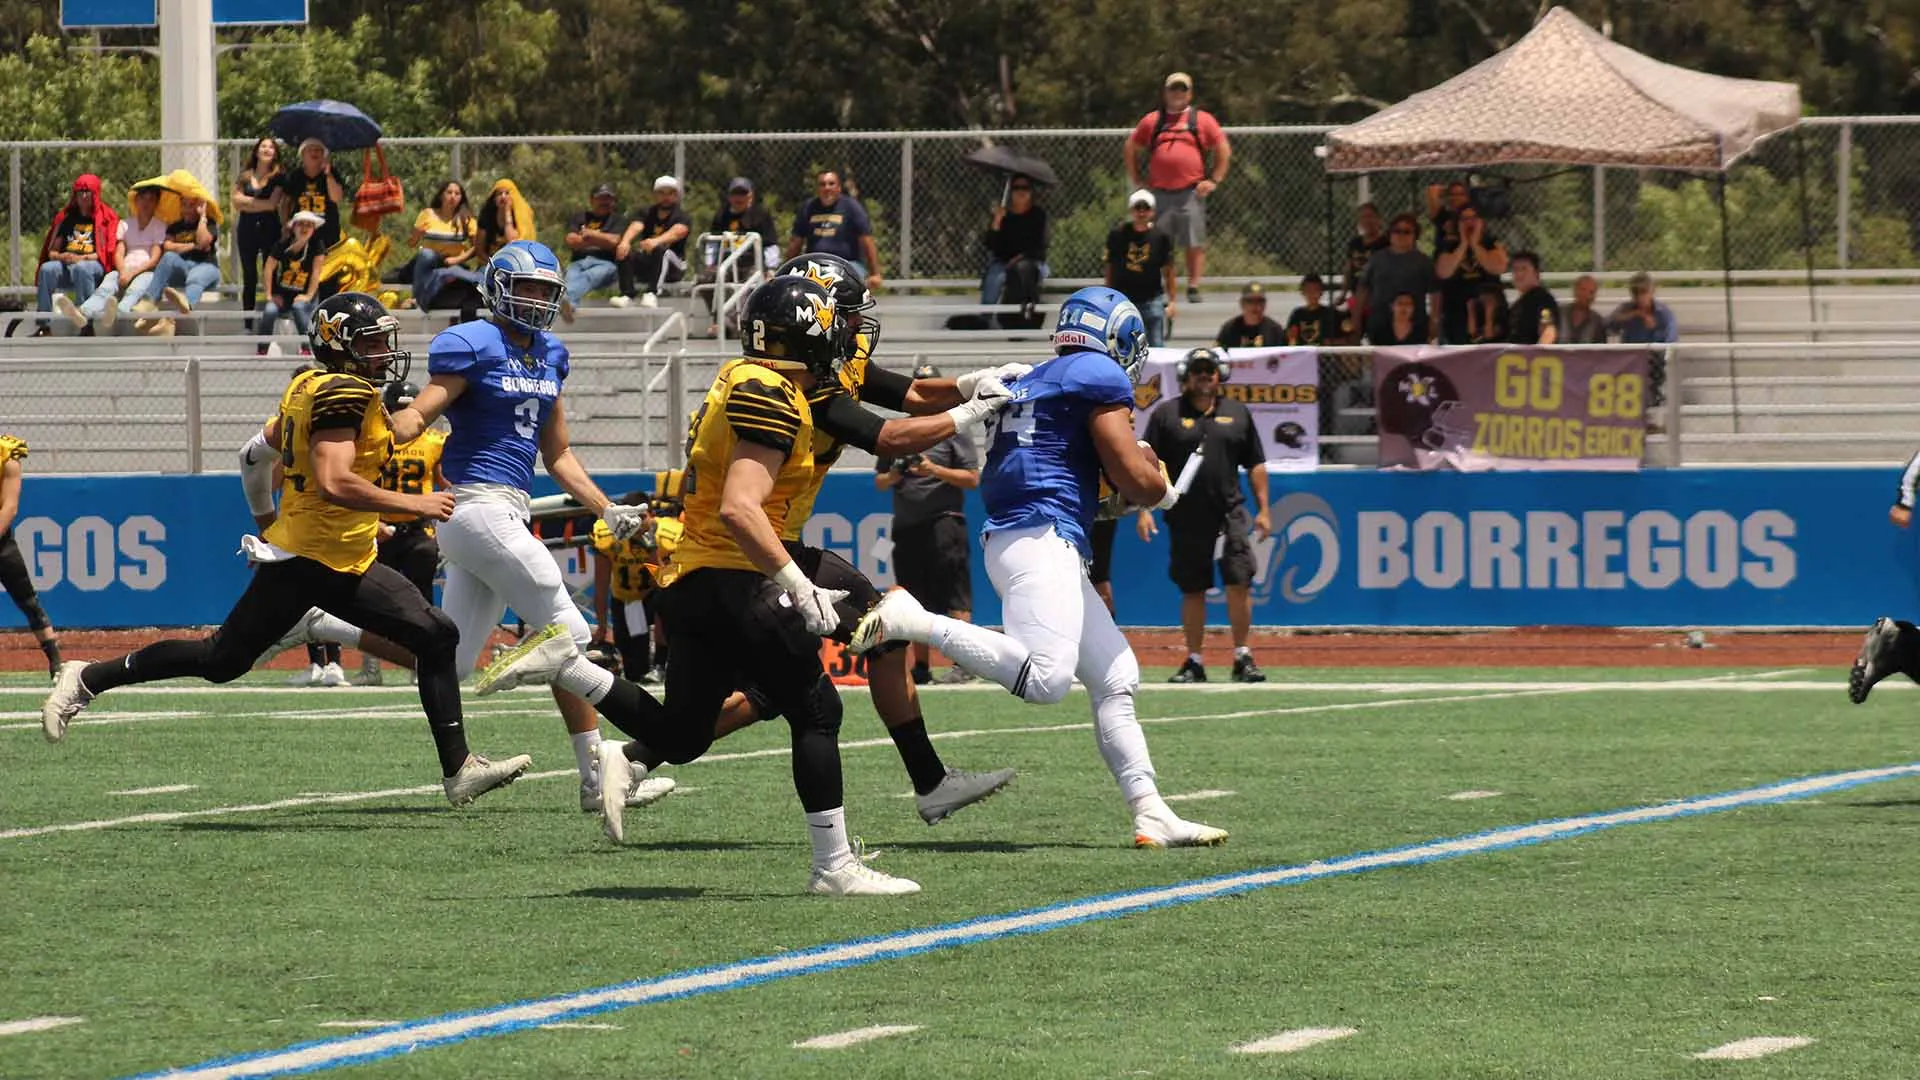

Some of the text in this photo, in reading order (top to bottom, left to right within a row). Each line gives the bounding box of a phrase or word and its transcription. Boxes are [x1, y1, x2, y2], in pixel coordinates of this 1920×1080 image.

[753, 320, 765, 351] 2
[502, 376, 559, 397] BORREGOS
[1215, 383, 1319, 404] RROS
[1495, 353, 1564, 412] GO
[1588, 373, 1644, 418] 88
[514, 398, 540, 440] 3
[1473, 413, 1584, 459] ZORROS
[1584, 426, 1645, 457] ERICK
[1357, 510, 1798, 589] BORREGOS
